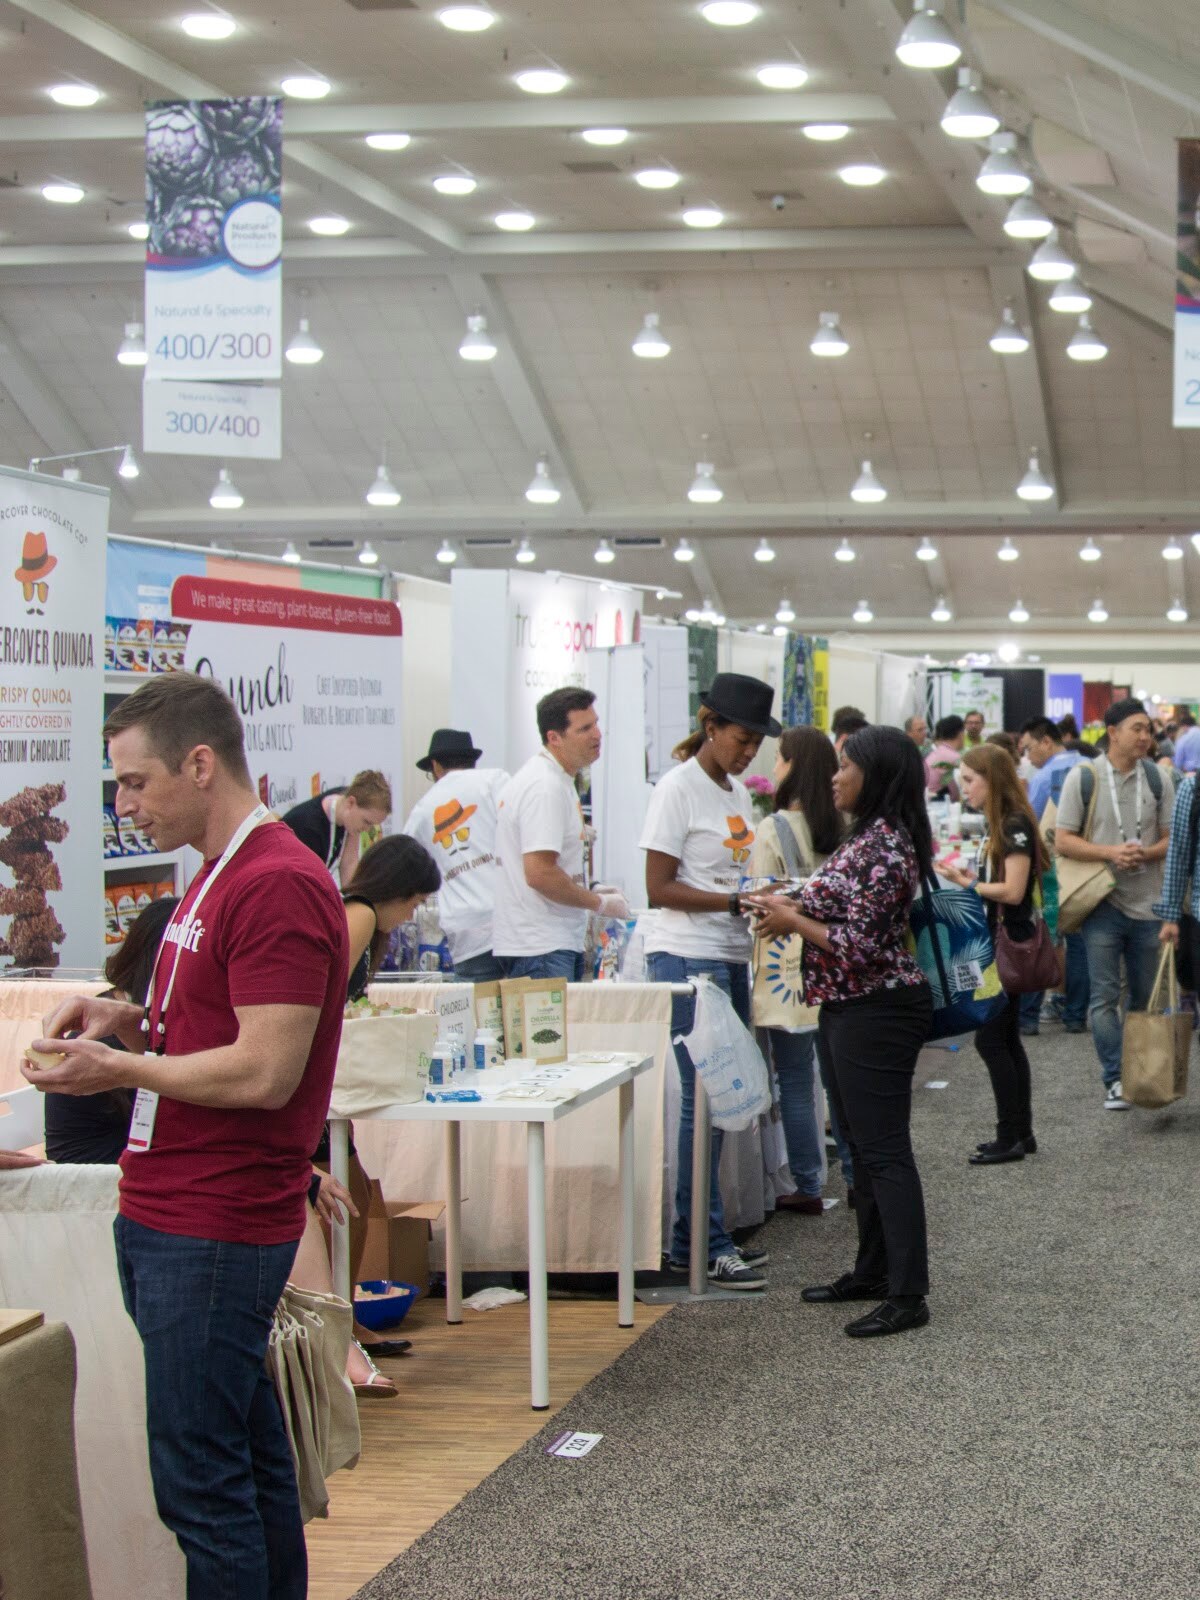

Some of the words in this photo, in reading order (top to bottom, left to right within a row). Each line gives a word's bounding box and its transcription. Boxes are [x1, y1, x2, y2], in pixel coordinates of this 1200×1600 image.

[154, 304, 201, 317] Natural
[203, 305, 213, 317] &
[215, 304, 273, 321] Specialty
[154, 333, 272, 361] 400/300
[165, 411, 260, 438] 300/400
[32, 505, 74, 534] CHOCOLATE
[190, 589, 207, 608] We
[207, 592, 232, 611] make
[53, 630, 94, 672] QUINOA
[32, 687, 72, 706] QUINOA
[25, 715, 62, 729] COVERED
[65, 715, 72, 729] IN
[246, 723, 293, 752] ORGANICS
[30, 738, 71, 763] CHOCOLATE
[440, 997, 470, 1016] CHLORELLA
